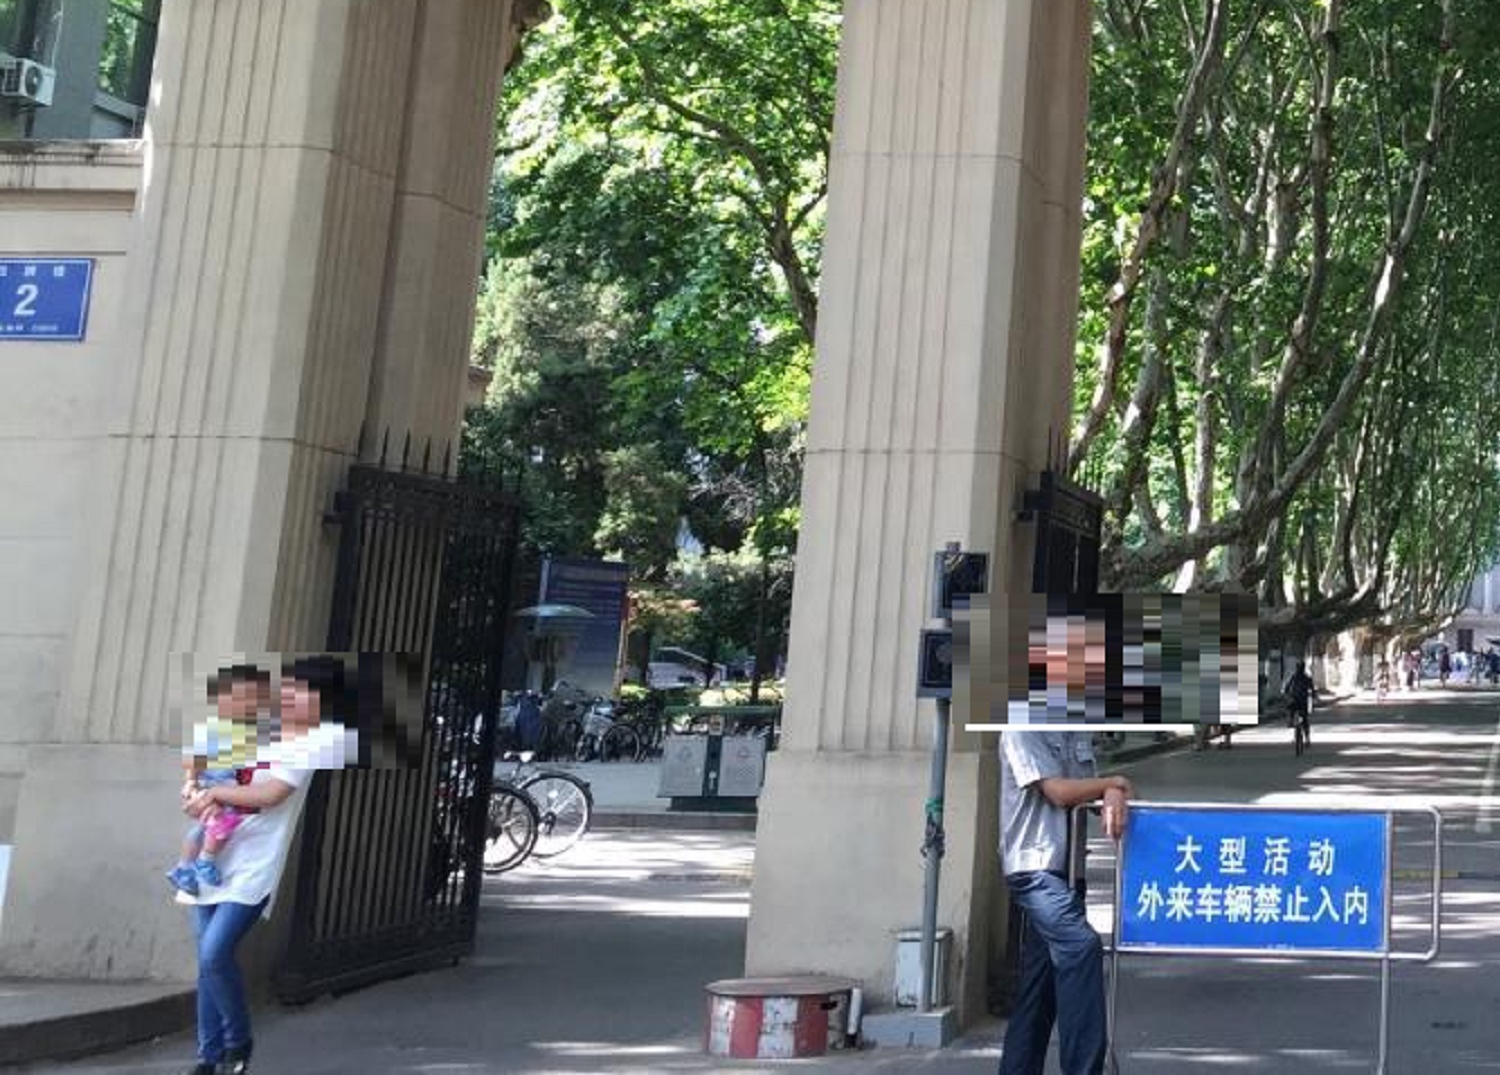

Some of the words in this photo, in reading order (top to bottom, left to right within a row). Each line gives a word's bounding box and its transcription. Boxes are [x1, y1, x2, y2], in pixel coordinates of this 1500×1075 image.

[14, 284, 38, 315] 2
[1175, 835, 1335, 877] 大型活动
[1137, 882, 1369, 925] 外来车辆禁止入内
